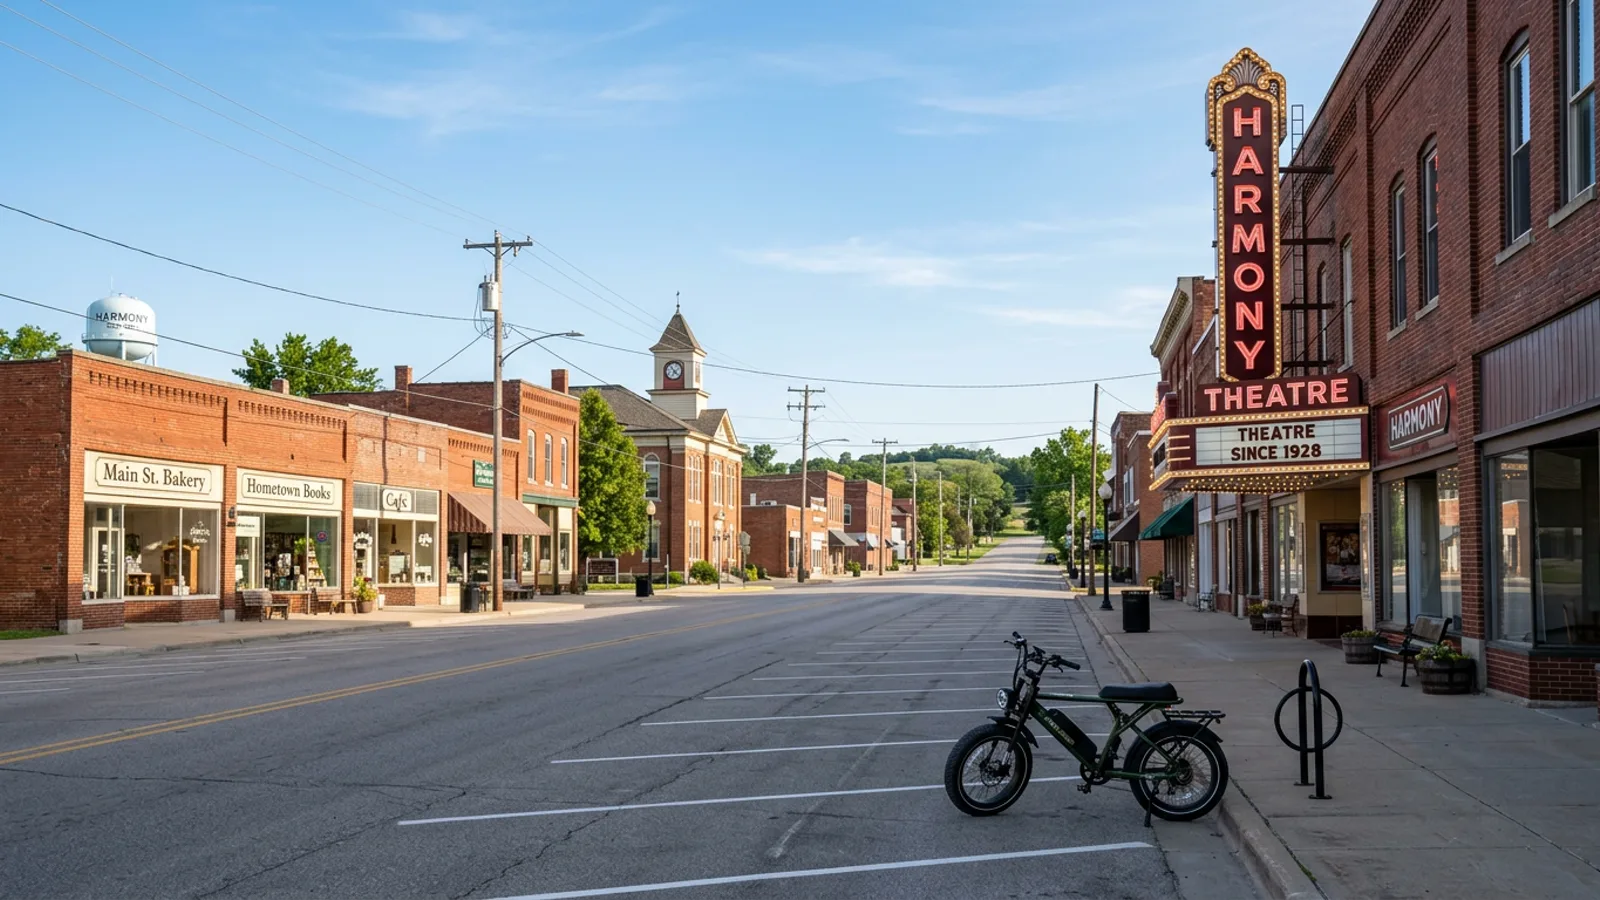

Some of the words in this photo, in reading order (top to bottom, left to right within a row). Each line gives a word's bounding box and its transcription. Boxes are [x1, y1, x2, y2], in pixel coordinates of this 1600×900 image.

[1232, 107, 1265, 370] HARMONY
[95, 312, 149, 323] HARMONY
[1204, 378, 1349, 411] THEATRE
[1390, 395, 1442, 441] HARMONY
[1238, 424, 1316, 441] THEATRE
[1231, 445, 1278, 461] SINCE
[1283, 443, 1322, 459] 1928
[103, 462, 139, 483] Main
[142, 466, 159, 485] St.
[163, 468, 206, 492] Bakery
[246, 477, 301, 497] Hometown
[303, 483, 331, 500] Books
